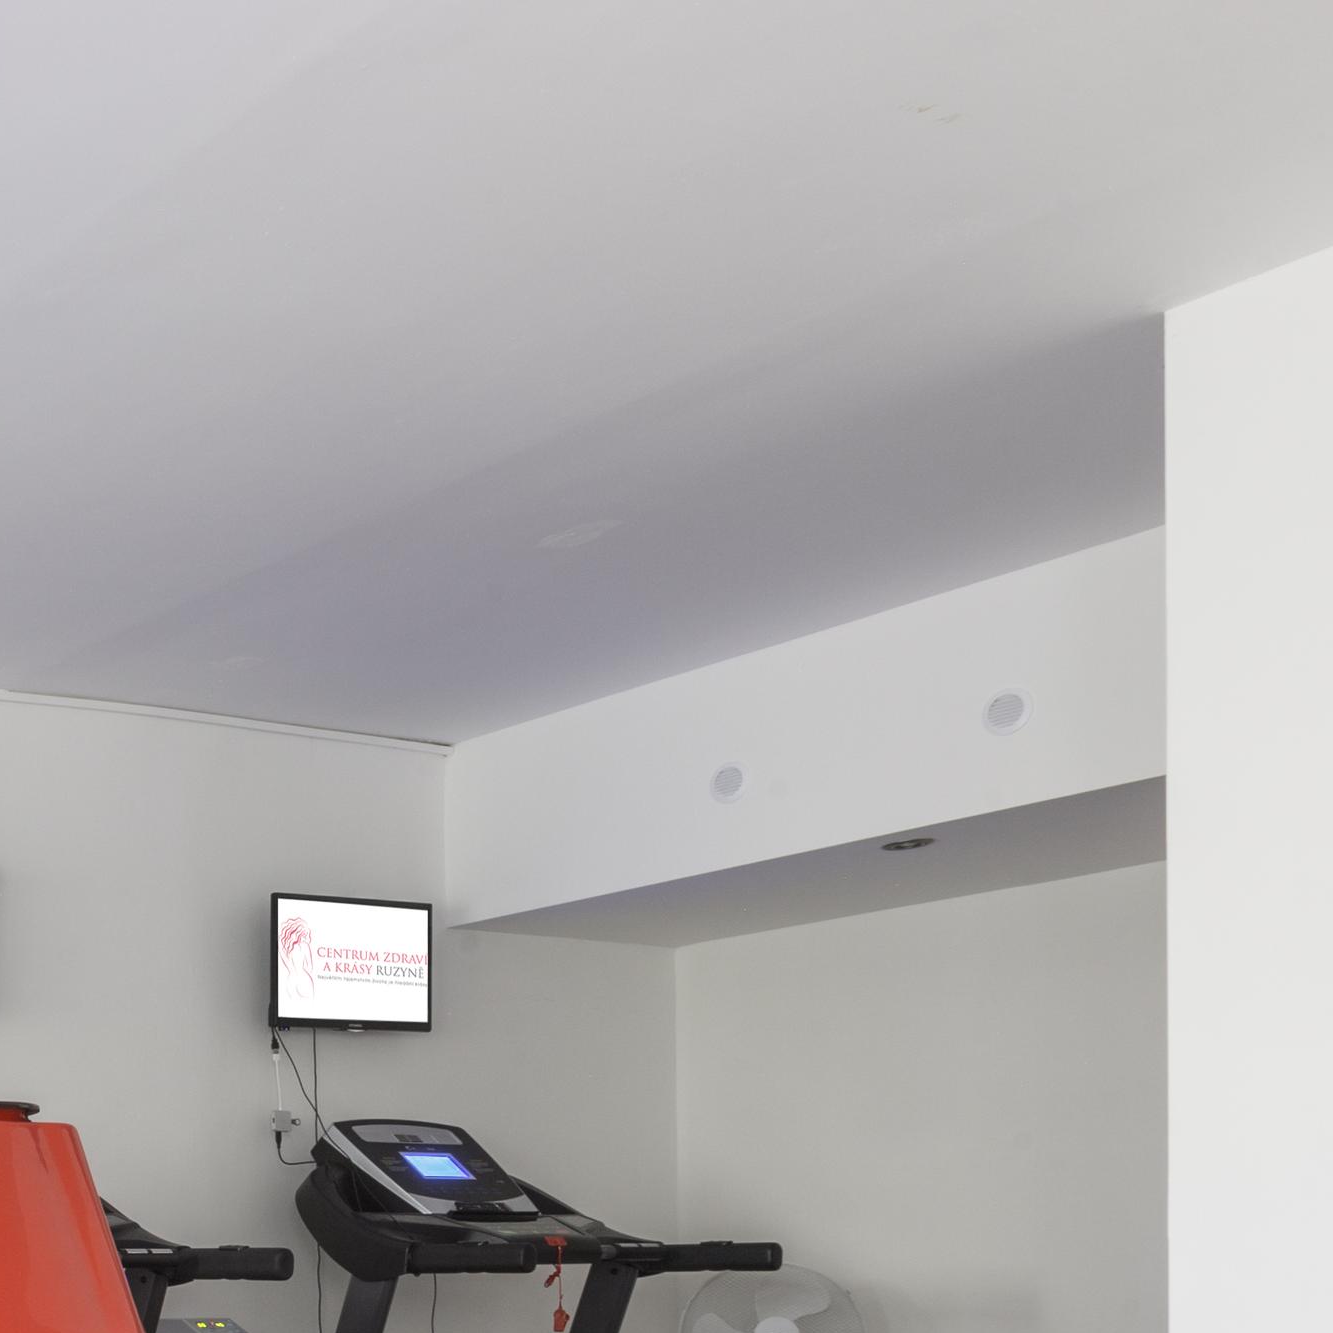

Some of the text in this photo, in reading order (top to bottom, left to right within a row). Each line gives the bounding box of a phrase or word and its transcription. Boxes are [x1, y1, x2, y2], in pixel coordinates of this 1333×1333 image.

[317, 946, 380, 962] CENTRUM
[323, 962, 331, 972] A
[335, 961, 373, 975] KRÁSY
